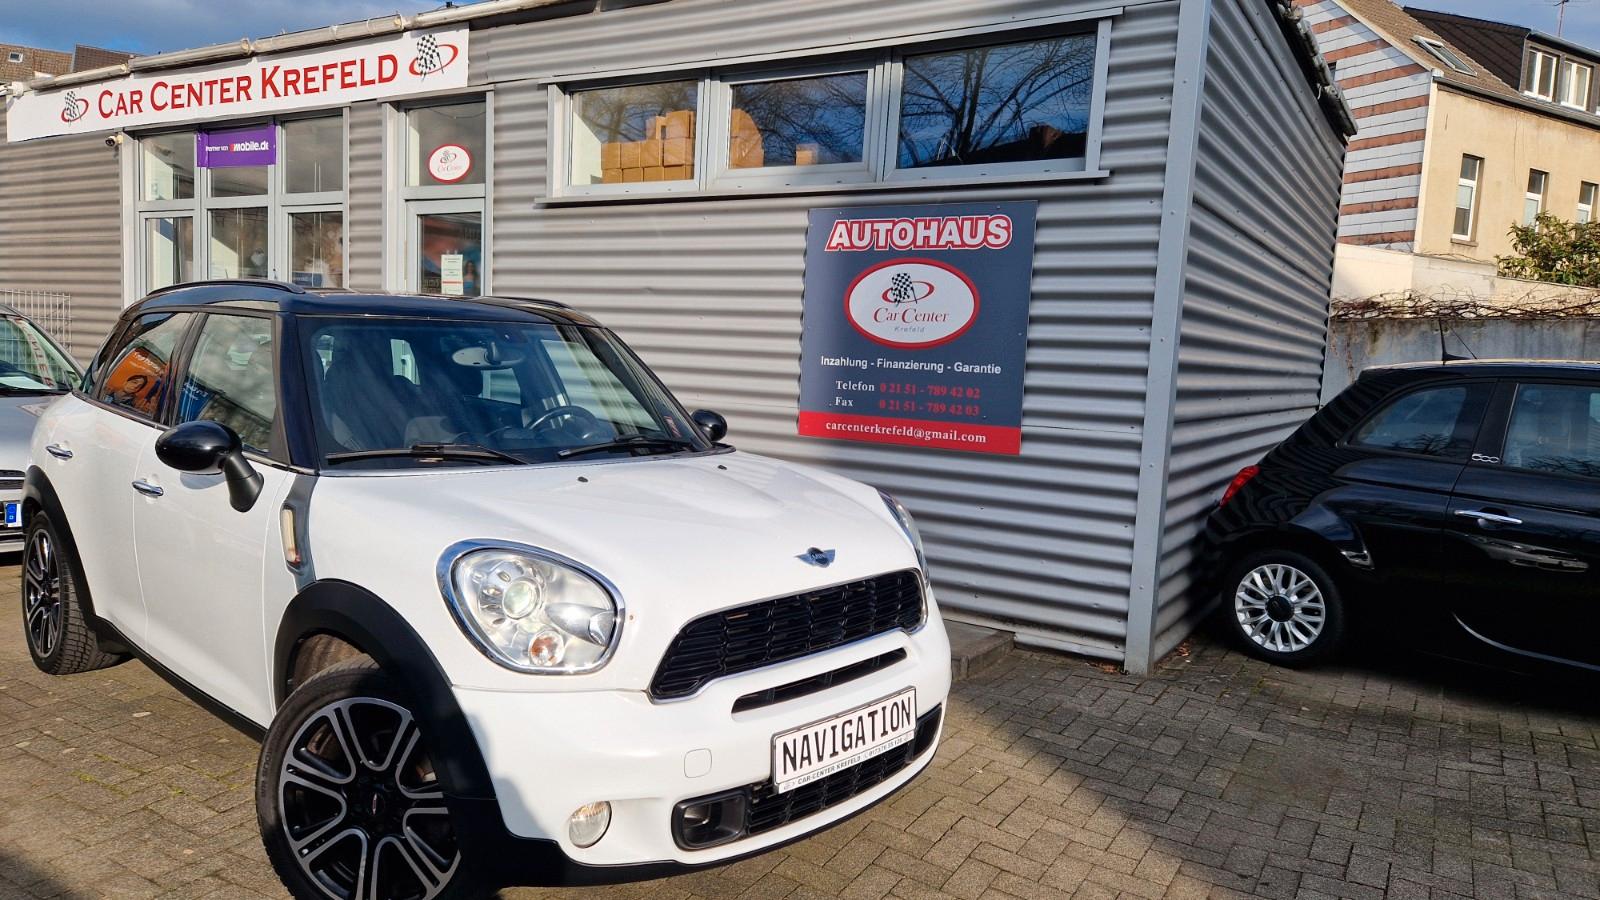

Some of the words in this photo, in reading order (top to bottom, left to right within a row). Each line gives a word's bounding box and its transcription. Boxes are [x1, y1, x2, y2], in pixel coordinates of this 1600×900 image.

[98, 89, 143, 119] CAR
[150, 75, 252, 111] CENTER
[261, 54, 398, 99] KREFELD
[825, 214, 1012, 251] AUTOHAUS
[873, 307, 899, 324] Car
[901, 307, 949, 325] Center
[821, 356, 868, 369] Inzahlung
[876, 358, 944, 374] Finanzierung
[954, 362, 1002, 375] Garantie
[836, 380, 875, 392] Telefon
[835, 397, 854, 407] Fax
[826, 421, 987, 443] carcenterkrefeld@gmail.com
[782, 696, 911, 776] NAVIGATION
